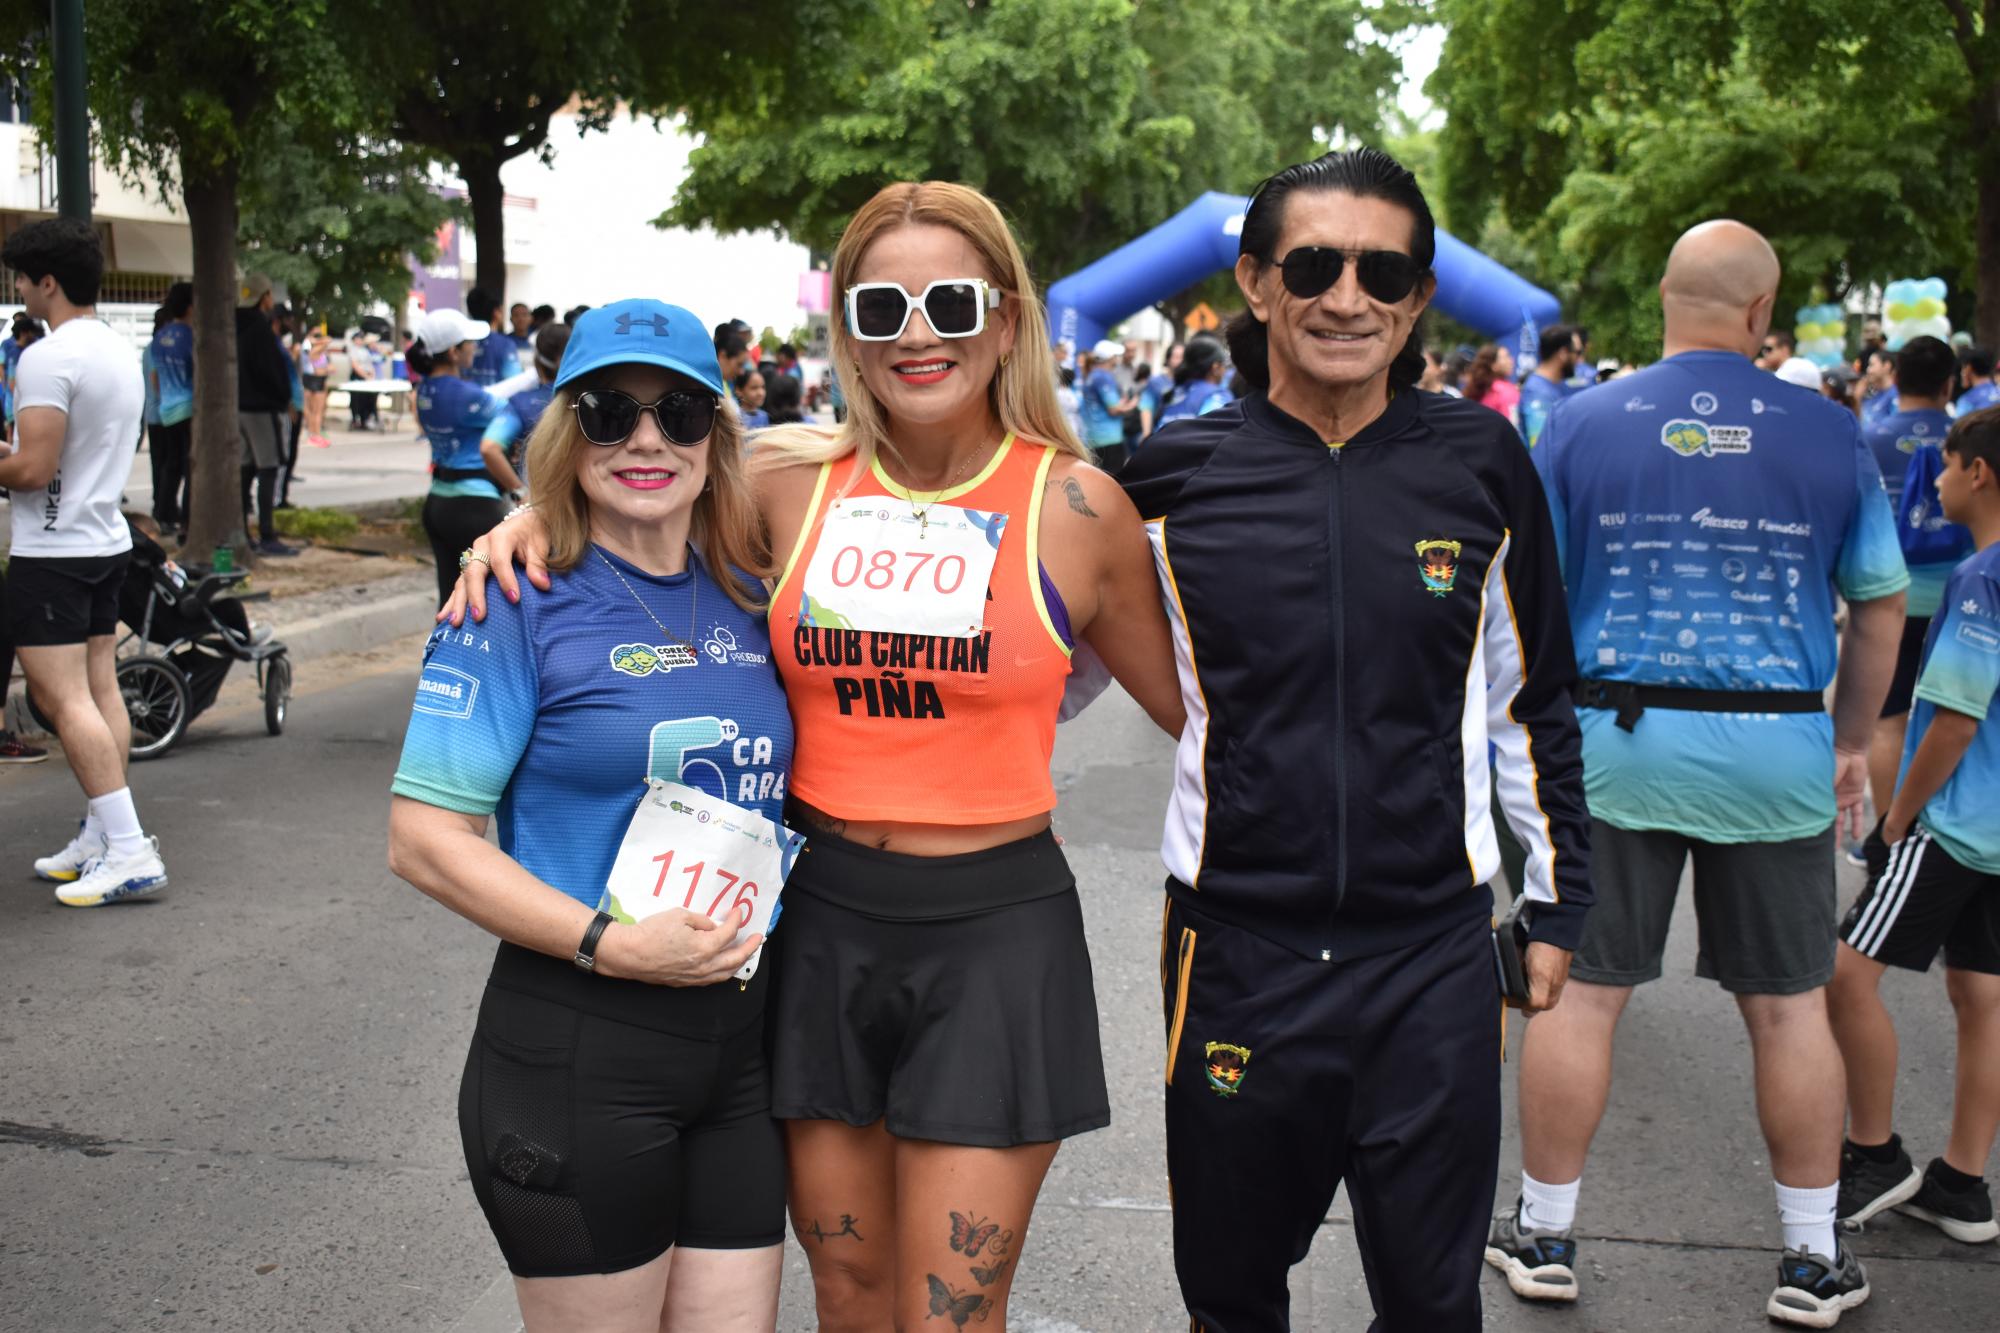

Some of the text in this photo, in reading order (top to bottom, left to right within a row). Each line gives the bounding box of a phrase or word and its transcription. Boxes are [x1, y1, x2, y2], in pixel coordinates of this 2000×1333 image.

[44, 479, 61, 531] NIKE
[1599, 512, 1626, 527] RIU
[830, 545, 967, 595] 0870
[664, 658, 696, 666] SUEÑOS
[793, 624, 864, 668] CLUB
[832, 669, 947, 720] PIÑA
[732, 736, 773, 767] CA
[651, 849, 759, 930] 1176
